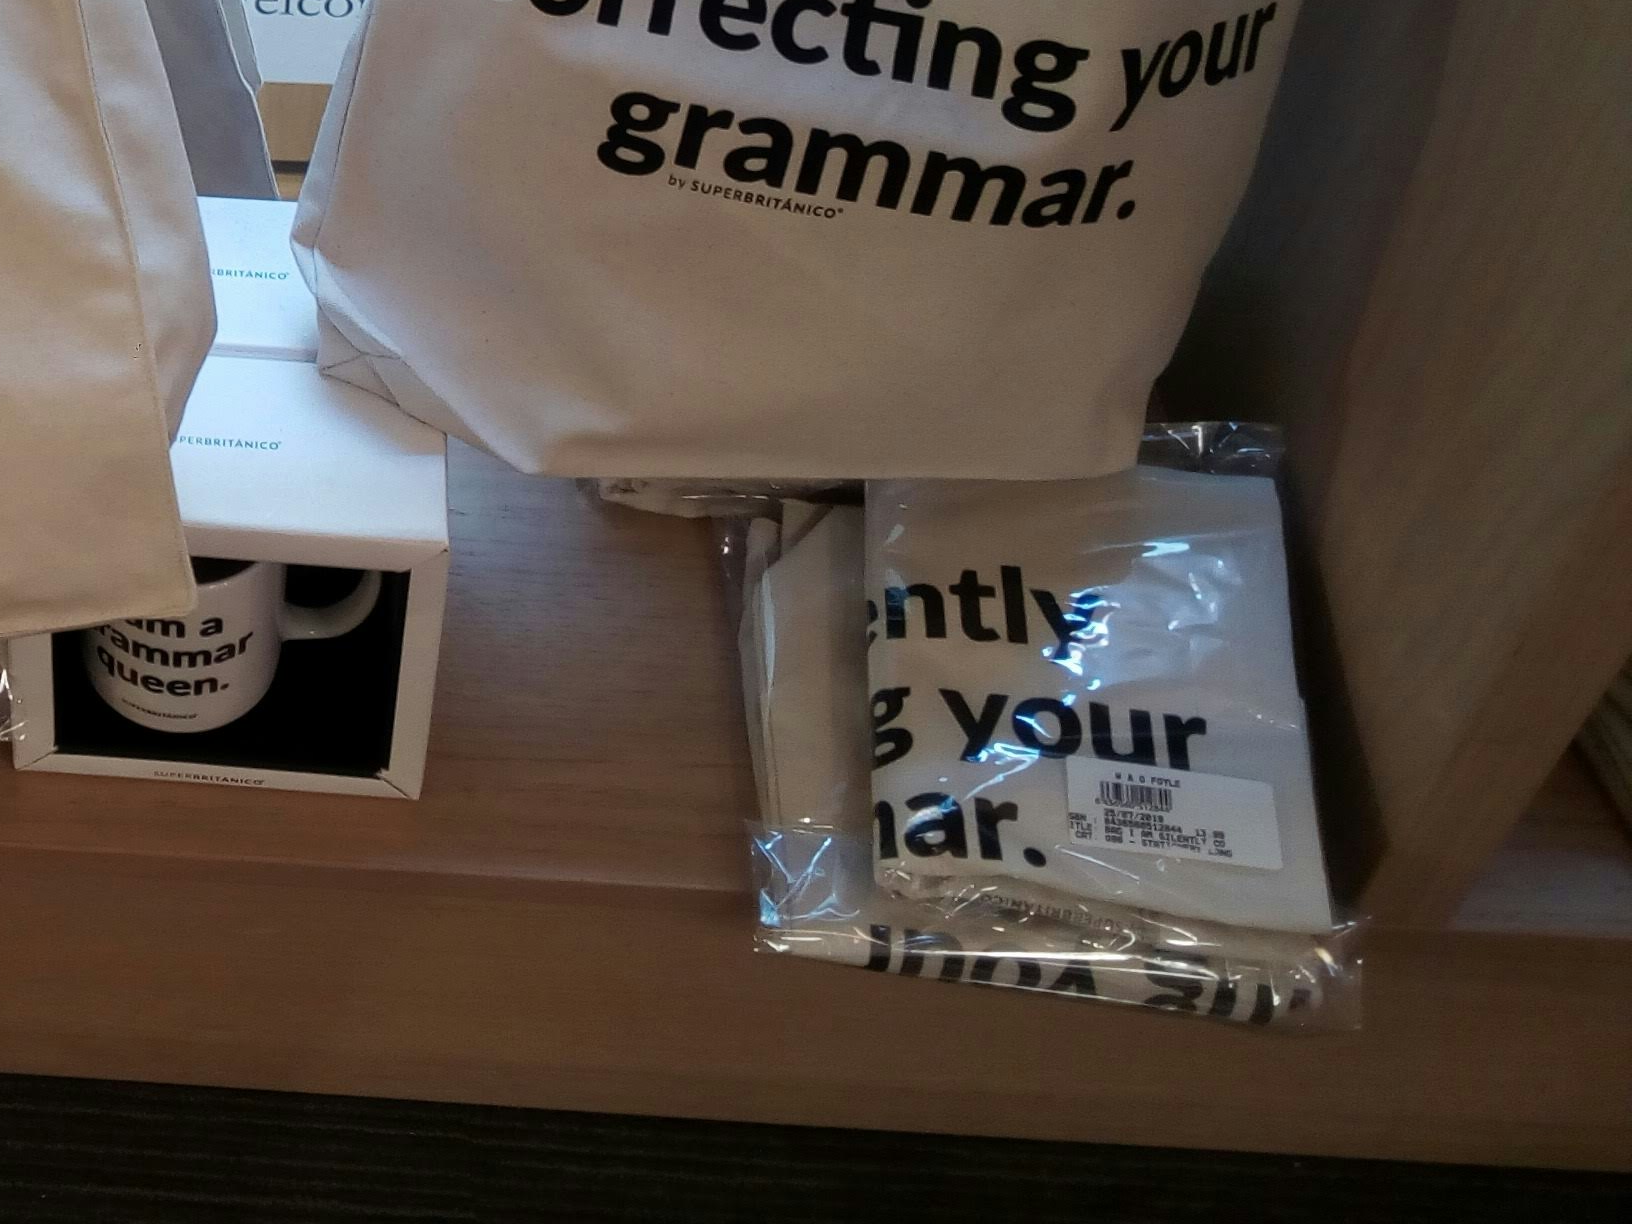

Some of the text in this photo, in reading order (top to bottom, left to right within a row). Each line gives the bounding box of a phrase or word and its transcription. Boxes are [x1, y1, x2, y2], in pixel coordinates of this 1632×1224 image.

[1109, 2, 1277, 132] your
[597, 92, 1135, 228] grammar.
[668, 174, 686, 189] by
[199, 617, 223, 637] a
[97, 645, 229, 697] queen.
[938, 688, 1207, 771] your
[1159, 832, 1207, 844] SILENTLY
